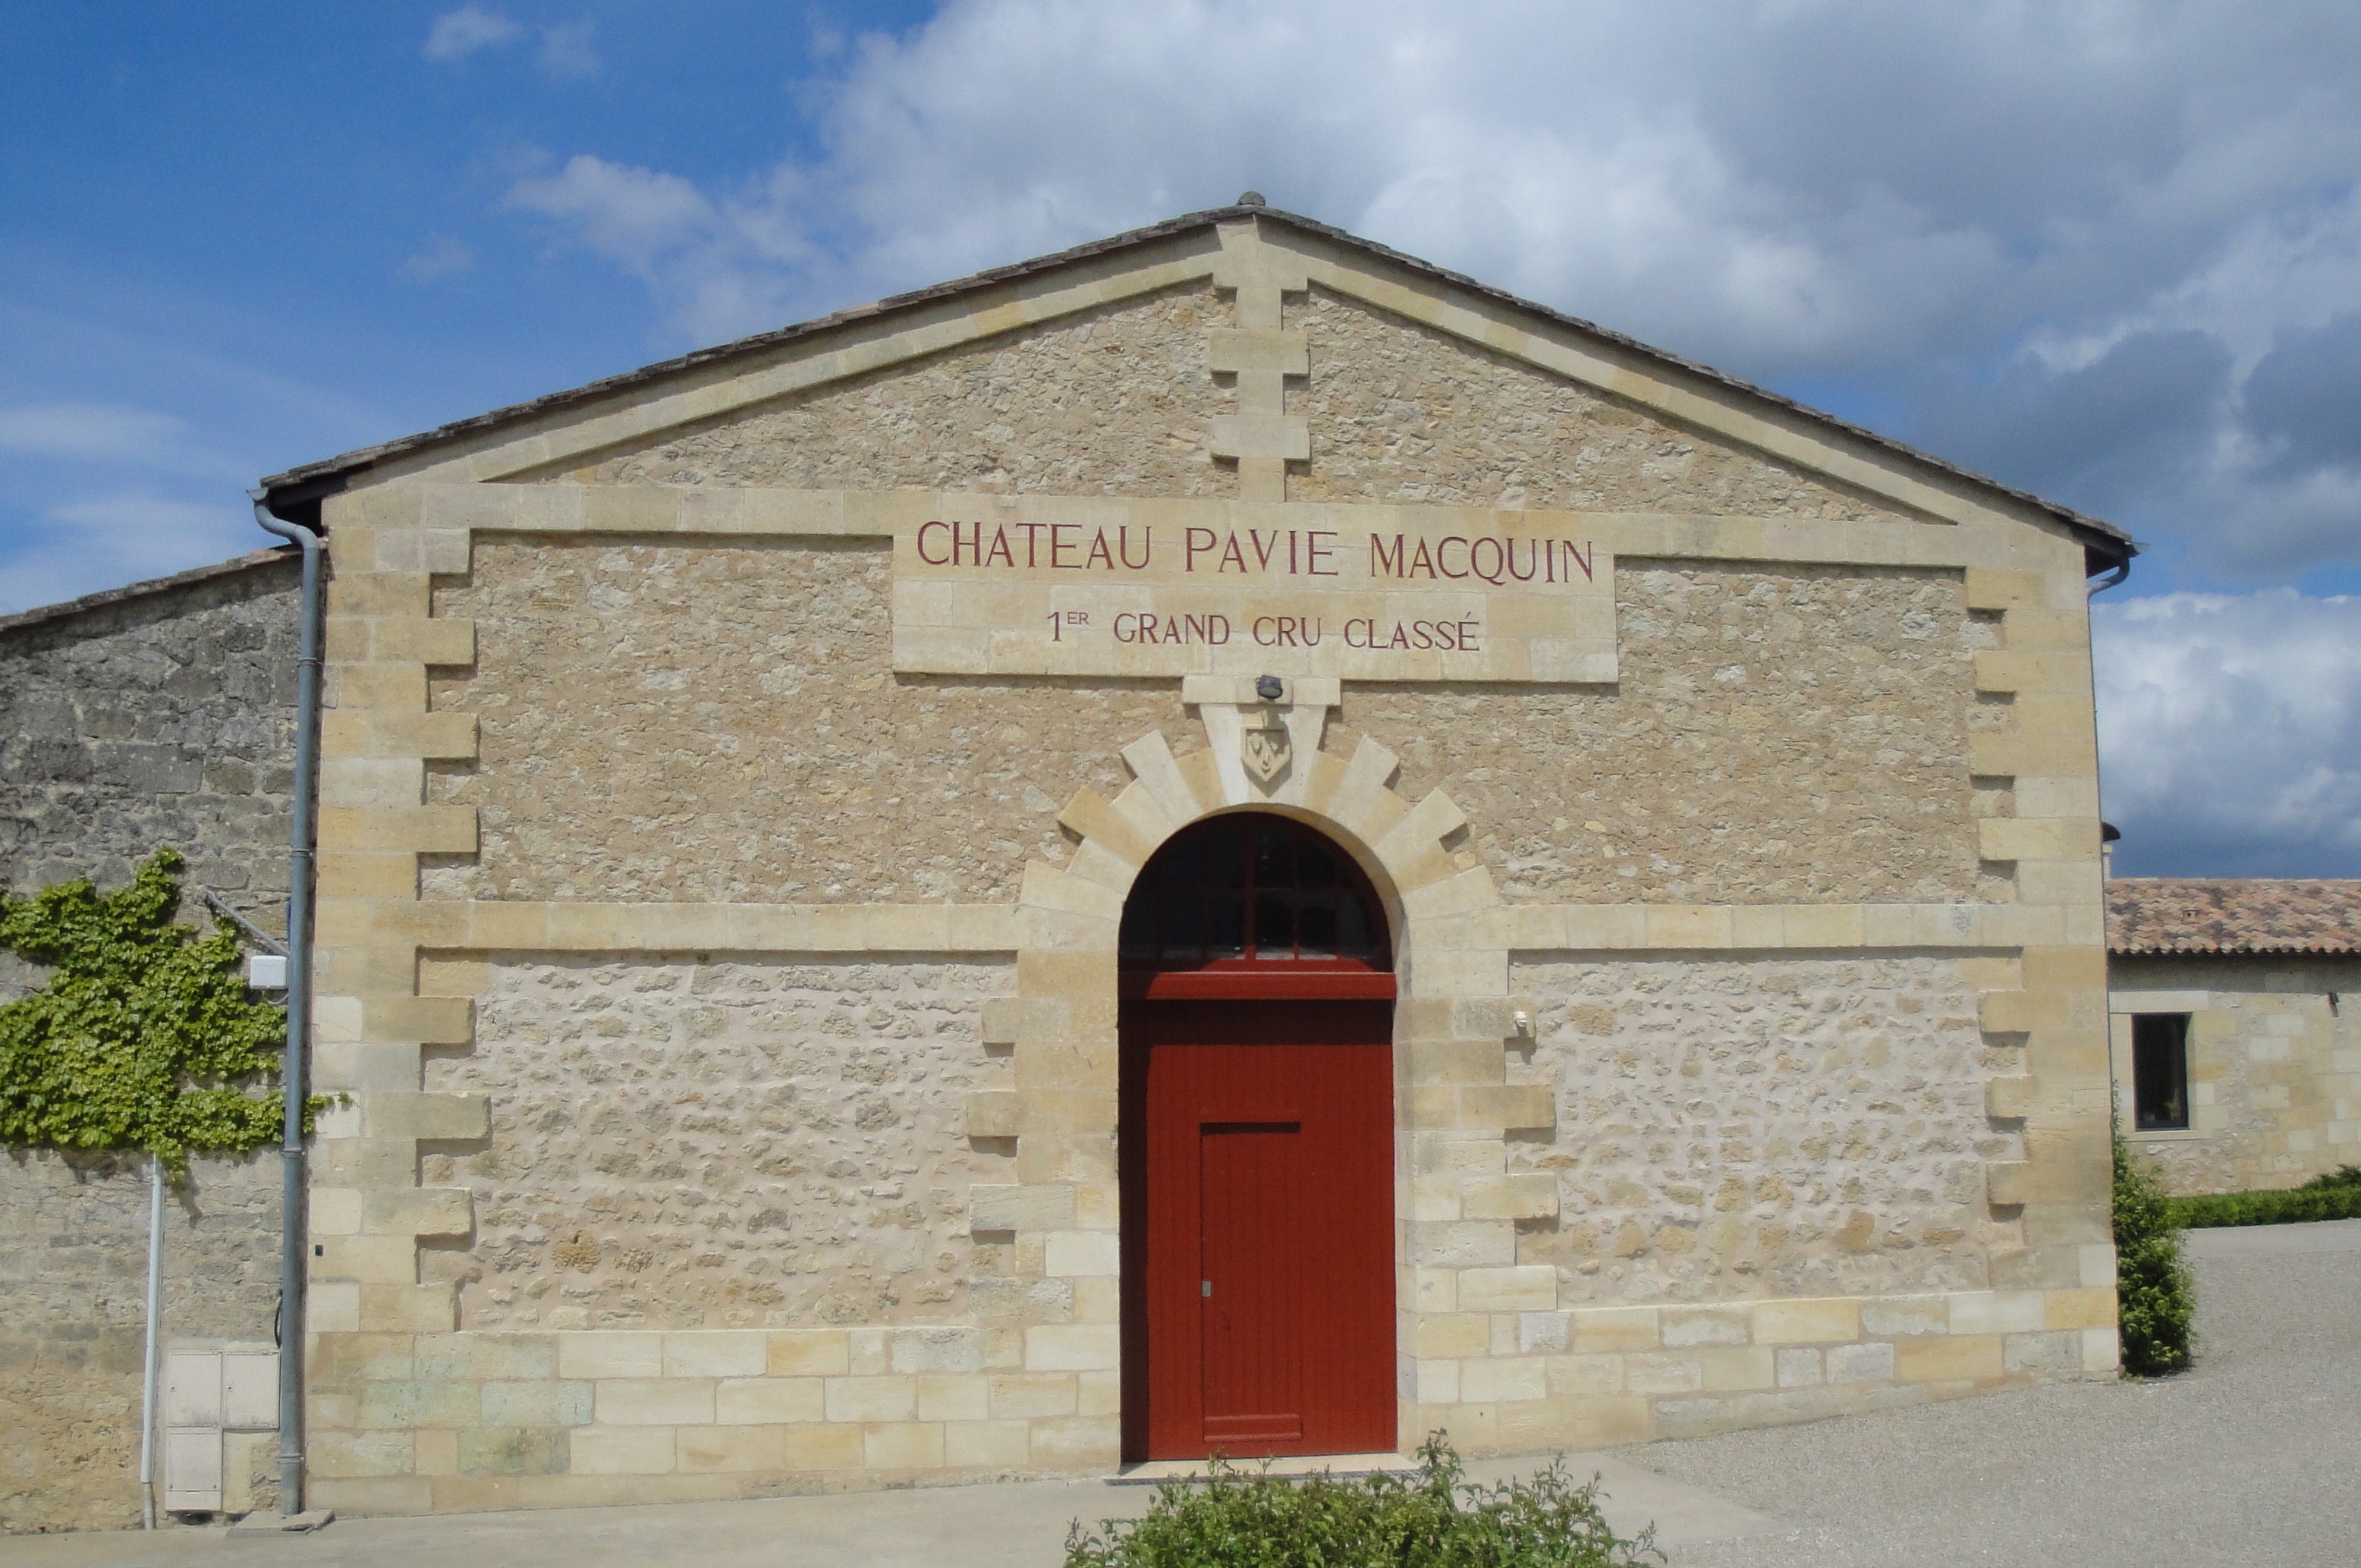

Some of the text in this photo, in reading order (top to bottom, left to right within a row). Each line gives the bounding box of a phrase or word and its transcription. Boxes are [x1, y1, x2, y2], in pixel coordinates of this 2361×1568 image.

[918, 520, 1593, 586] CHATEAU PAVIE MACQUIN
[1114, 613, 1230, 646] GRAND
[1253, 617, 1322, 647] CRU
[1344, 611, 1480, 652] CLASSÉ
